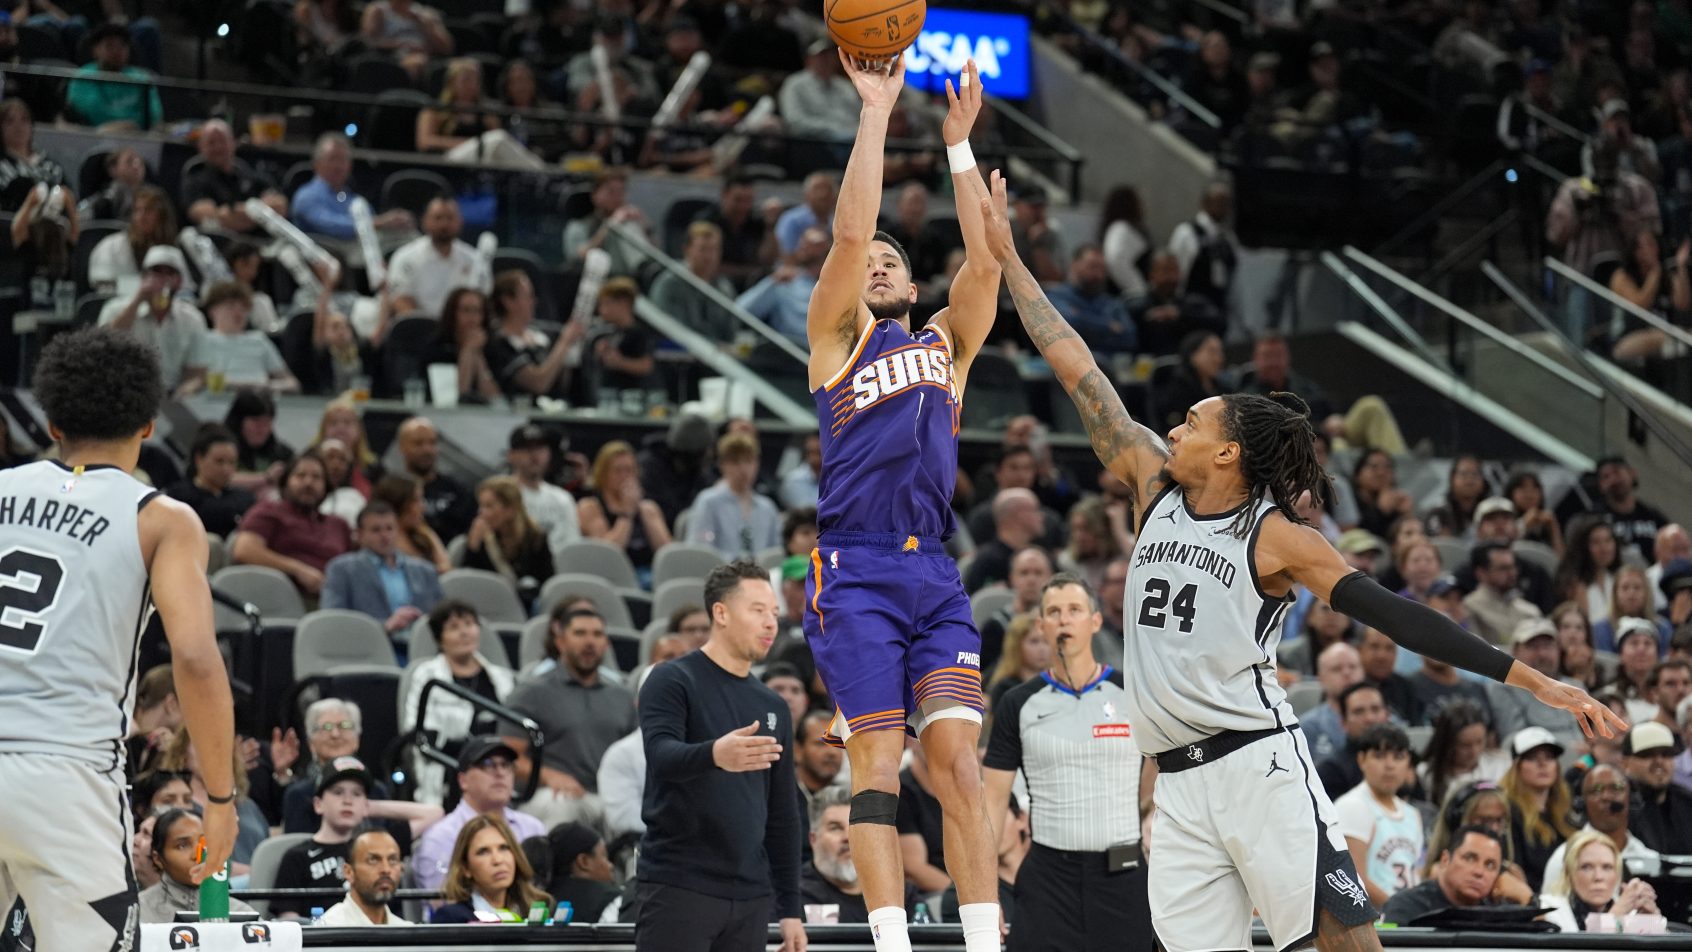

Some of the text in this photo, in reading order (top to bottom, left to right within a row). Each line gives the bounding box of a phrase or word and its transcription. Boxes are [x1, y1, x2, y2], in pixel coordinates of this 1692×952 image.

[852, 348, 948, 410] SUNS
[0, 496, 110, 547] HARPER
[0, 546, 67, 655] 2
[1137, 577, 1199, 634] 24
